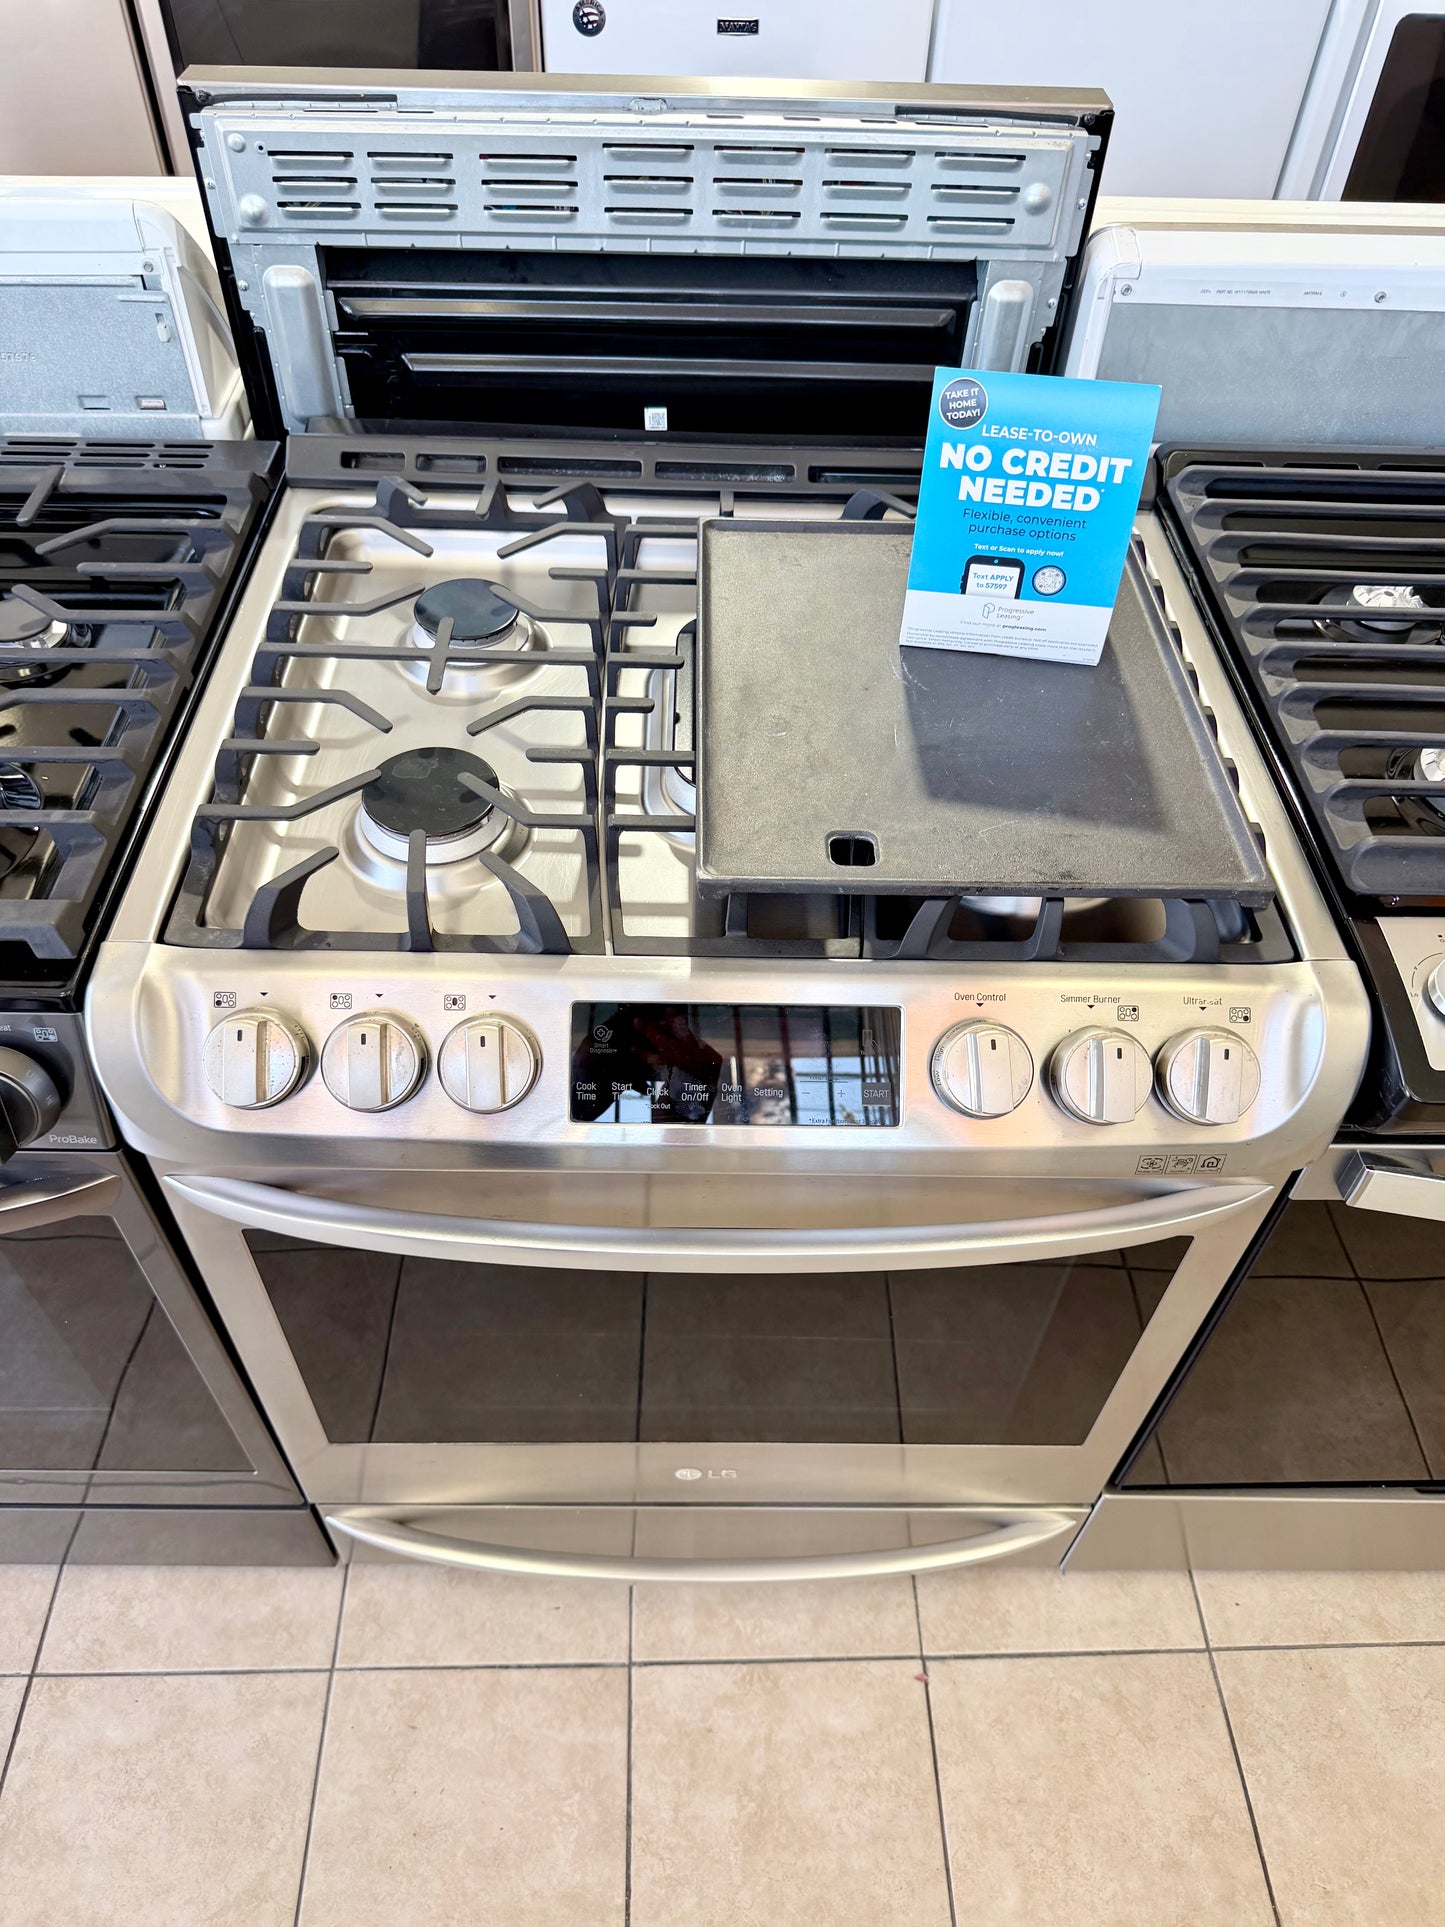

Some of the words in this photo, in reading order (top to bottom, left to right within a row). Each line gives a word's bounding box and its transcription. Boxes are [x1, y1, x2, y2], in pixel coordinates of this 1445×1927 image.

[574, 0, 604, 16] AMRICA
[945, 389, 969, 399] TAKE
[971, 388, 979, 396] IT
[949, 399, 977, 409] HOME
[946, 409, 981, 420] TODAY!
[982, 424, 1097, 447] LEASE-TO-OWN
[940, 442, 992, 472] NO
[1002, 448, 1133, 484] CREDIT
[963, 508, 1013, 524] Flexible,
[1016, 514, 1087, 529] convenient
[968, 524, 1026, 537] purchase
[1028, 529, 1076, 541] options
[998, 606, 1035, 616] Progressive
[1002, 624, 1047, 632] progleasing.com
[954, 993, 974, 1001] Oven
[977, 993, 1006, 1001] Control
[1060, 994, 1091, 1003] Simmer
[1094, 995, 1121, 1004] Burner
[576, 1082, 597, 1091] Cook
[612, 1082, 632, 1091] Start
[684, 1083, 707, 1091] Timer
[722, 1083, 742, 1092] Oven
[576, 1092, 596, 1100] Time
[681, 1093, 709, 1101] On/Off
[722, 1093, 742, 1103] Light
[754, 1088, 783, 1098] Setting
[49, 1135, 98, 1144] ProBake
[708, 1470, 737, 1479] LG
